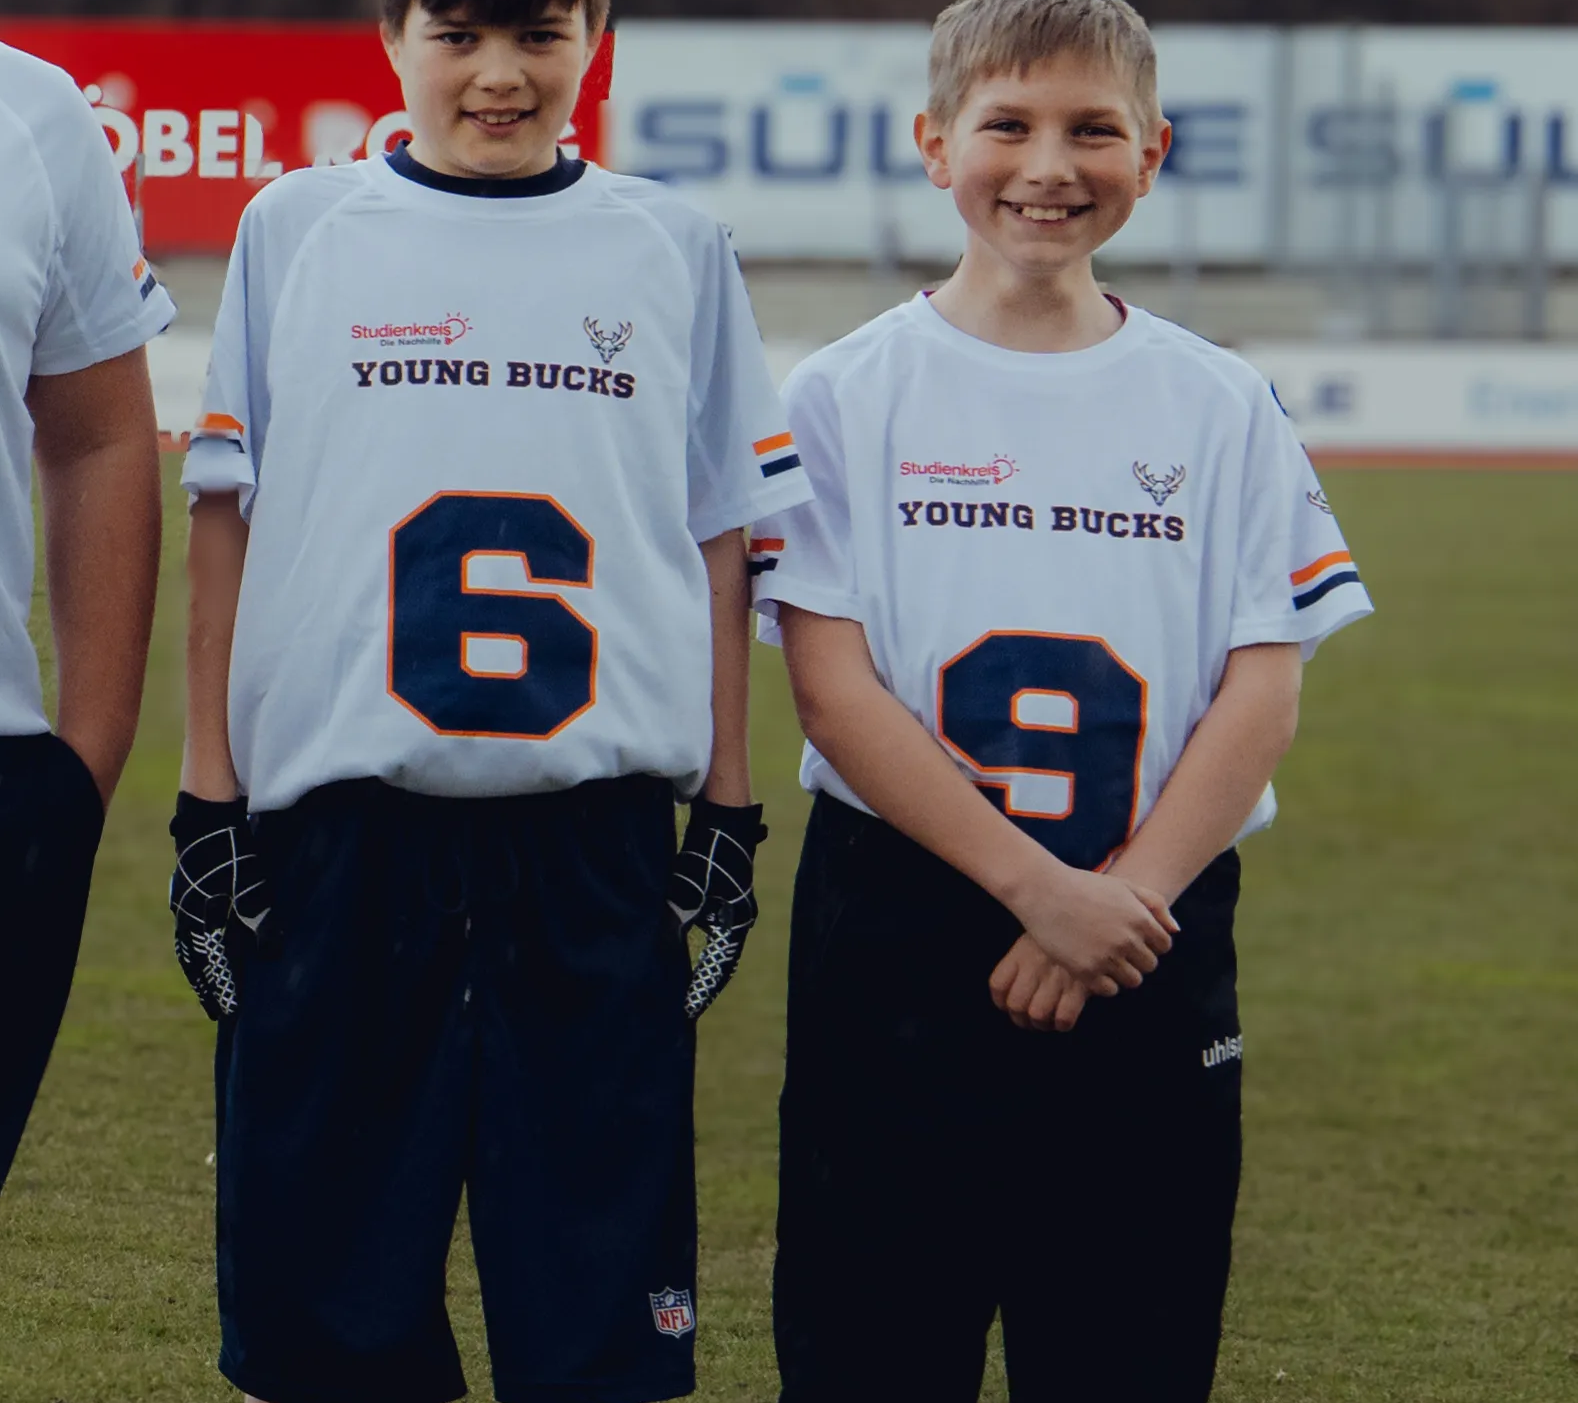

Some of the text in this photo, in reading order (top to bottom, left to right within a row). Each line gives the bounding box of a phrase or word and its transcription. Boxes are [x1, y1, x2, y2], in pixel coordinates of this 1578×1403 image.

[636, 75, 1248, 181] SÜLE
[351, 322, 452, 339] Studienkreis
[380, 339, 395, 347] Die
[352, 359, 636, 399] YOUNG BUCKS
[900, 461, 1000, 477] Studienkreis
[929, 476, 944, 484] Die
[898, 501, 1185, 542] YOUNG BUCKS
[386, 490, 598, 739] 6
[938, 629, 1148, 872] 9
[657, 1308, 690, 1330] NFL
